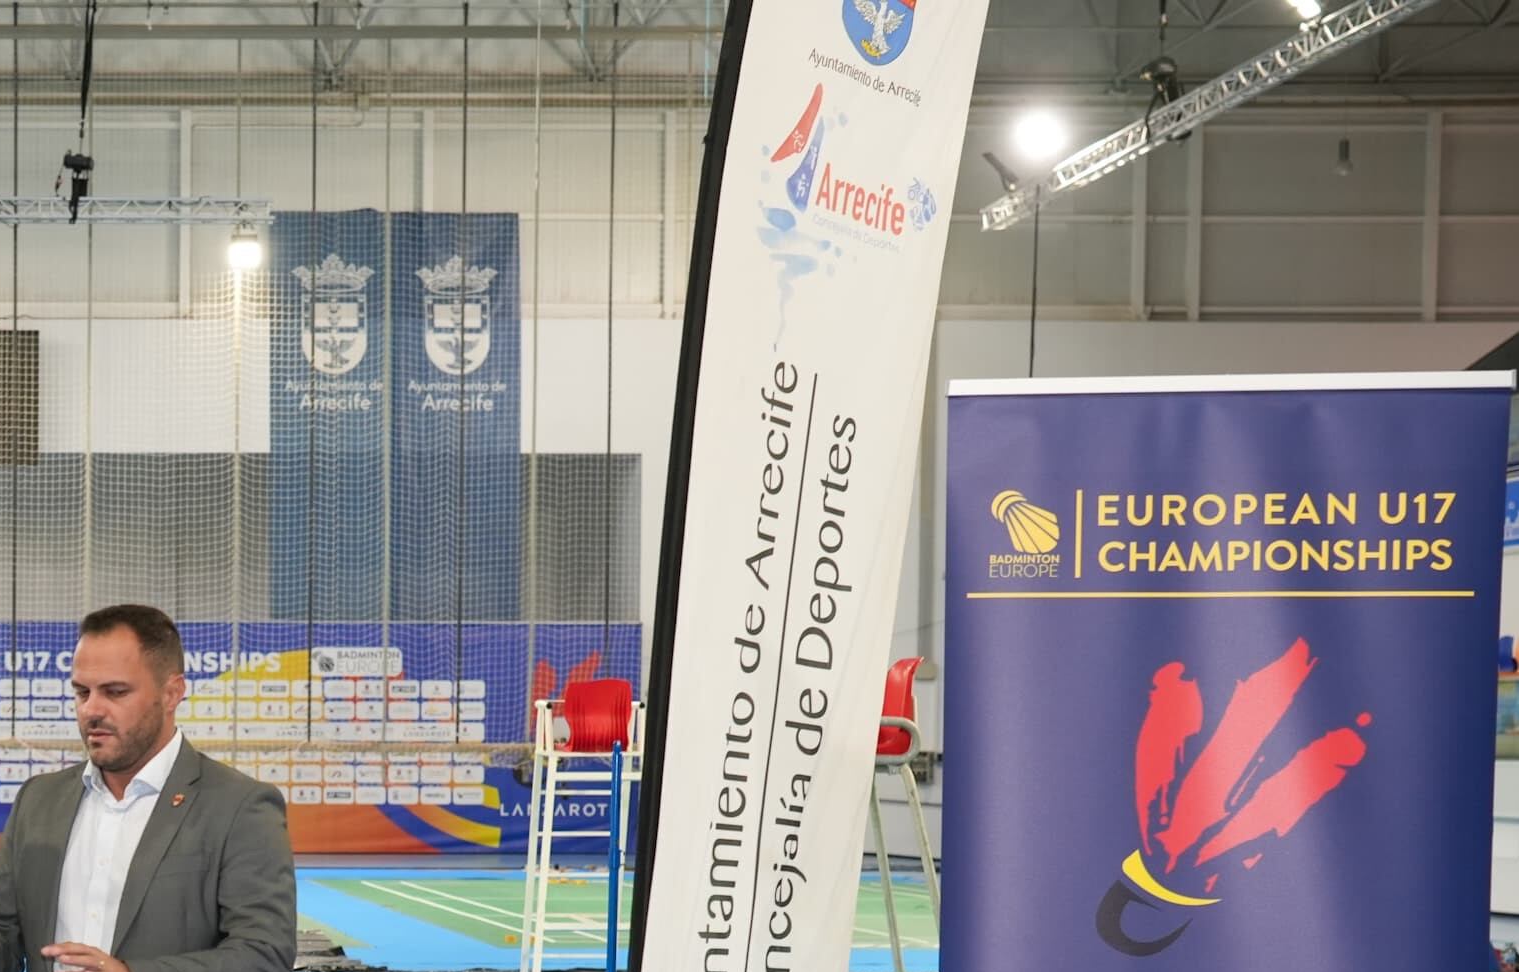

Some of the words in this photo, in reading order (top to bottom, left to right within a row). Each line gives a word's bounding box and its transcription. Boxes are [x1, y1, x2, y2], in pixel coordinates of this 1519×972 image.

[808, 47, 872, 87] Ayuntamiento
[872, 75, 885, 93] de
[815, 162, 905, 236] Arrecife
[298, 393, 372, 411] Arrecife
[408, 380, 489, 394] Ayuntamento
[492, 381, 506, 392] de
[421, 393, 494, 411] Arrecife
[745, 361, 798, 590] Arrecife
[1097, 492, 1357, 527] EUROPEAN
[1378, 492, 1457, 525] U17
[795, 415, 857, 670] Deportes
[989, 554, 1060, 564] BADMINTON
[1097, 538, 1453, 573] CHAMPIONSHIPS
[989, 564, 1058, 578] EUROPE
[734, 604, 766, 673] de
[4, 651, 51, 672] U17
[785, 688, 828, 756] de
[499, 803, 609, 817] LAAROT
